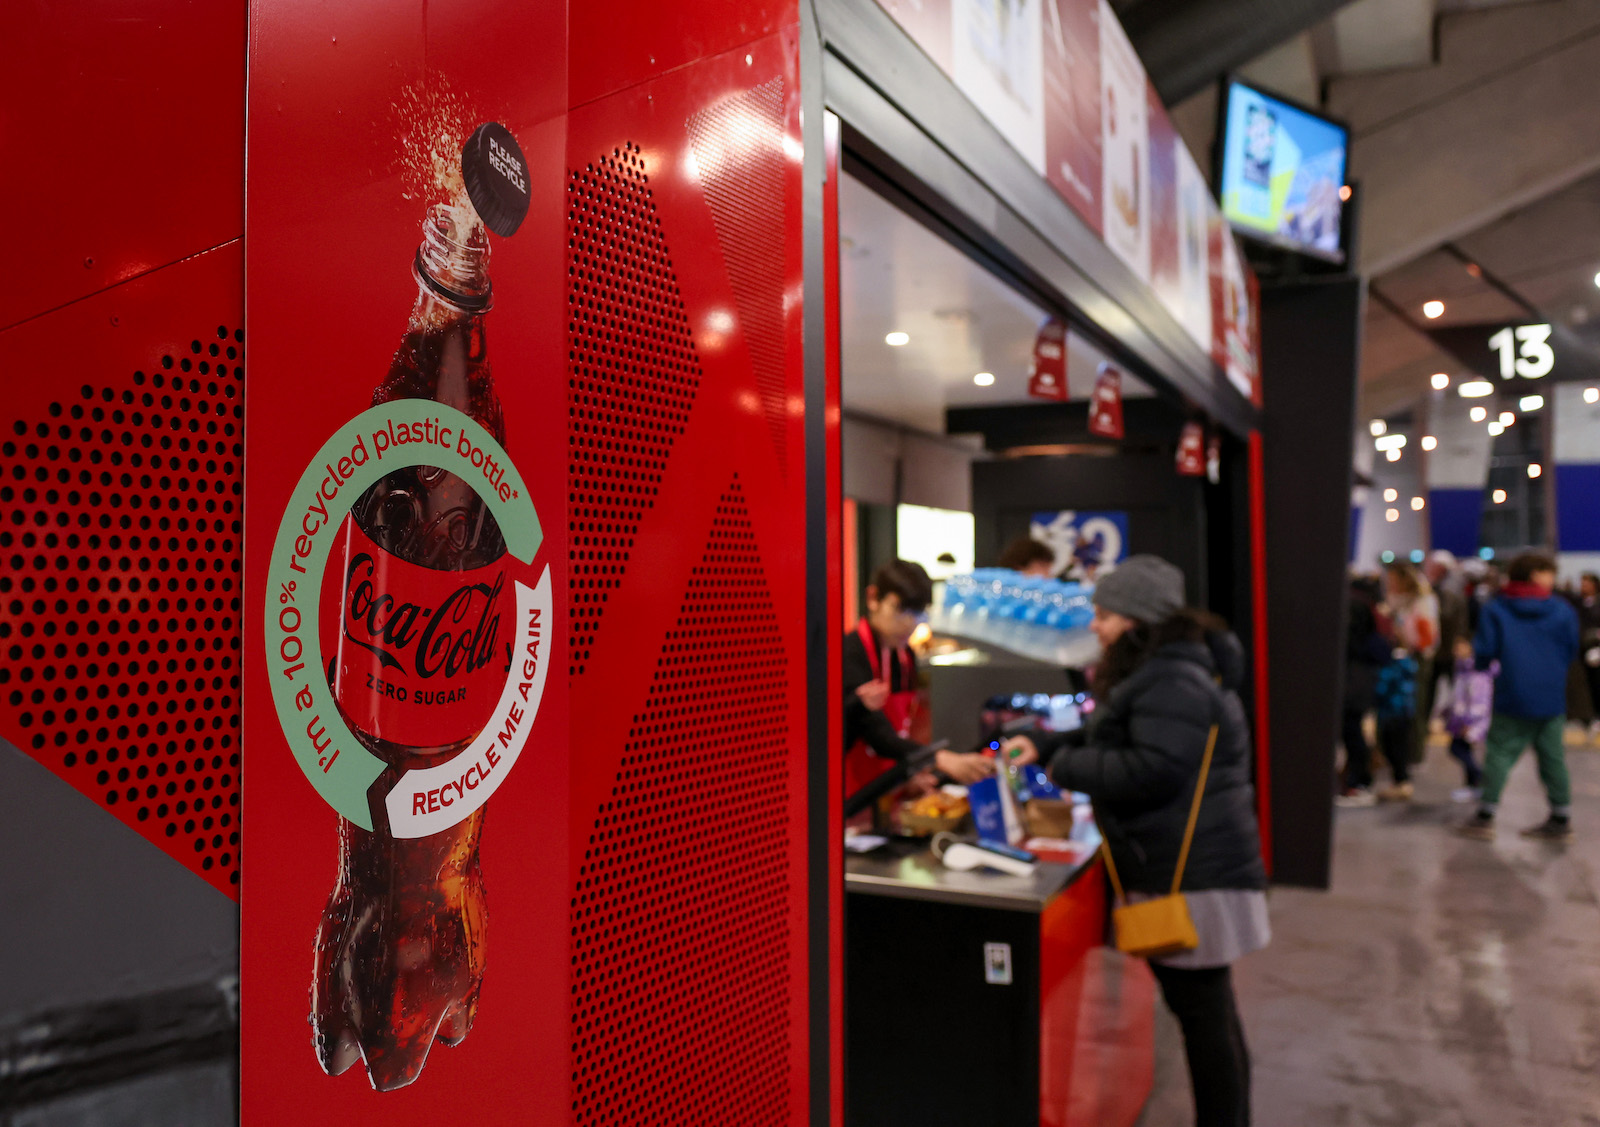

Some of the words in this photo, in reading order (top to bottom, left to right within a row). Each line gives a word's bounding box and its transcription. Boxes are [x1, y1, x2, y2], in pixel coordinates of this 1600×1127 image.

[488, 151, 527, 194] RECYCLE
[489, 137, 523, 176] PLEASE
[1488, 323, 1555, 380] 13
[373, 418, 453, 460] plastic
[289, 434, 370, 574] recycled
[279, 580, 305, 681] 100%
[344, 552, 505, 679] Coca-Cola
[295, 684, 314, 712] a
[366, 672, 408, 702] ZERO
[414, 687, 467, 705] SUGAR
[412, 743, 502, 816] RECYCLE
[497, 701, 525, 750] ME
[518, 608, 541, 703] AGAIN
[307, 714, 341, 774] I'm
